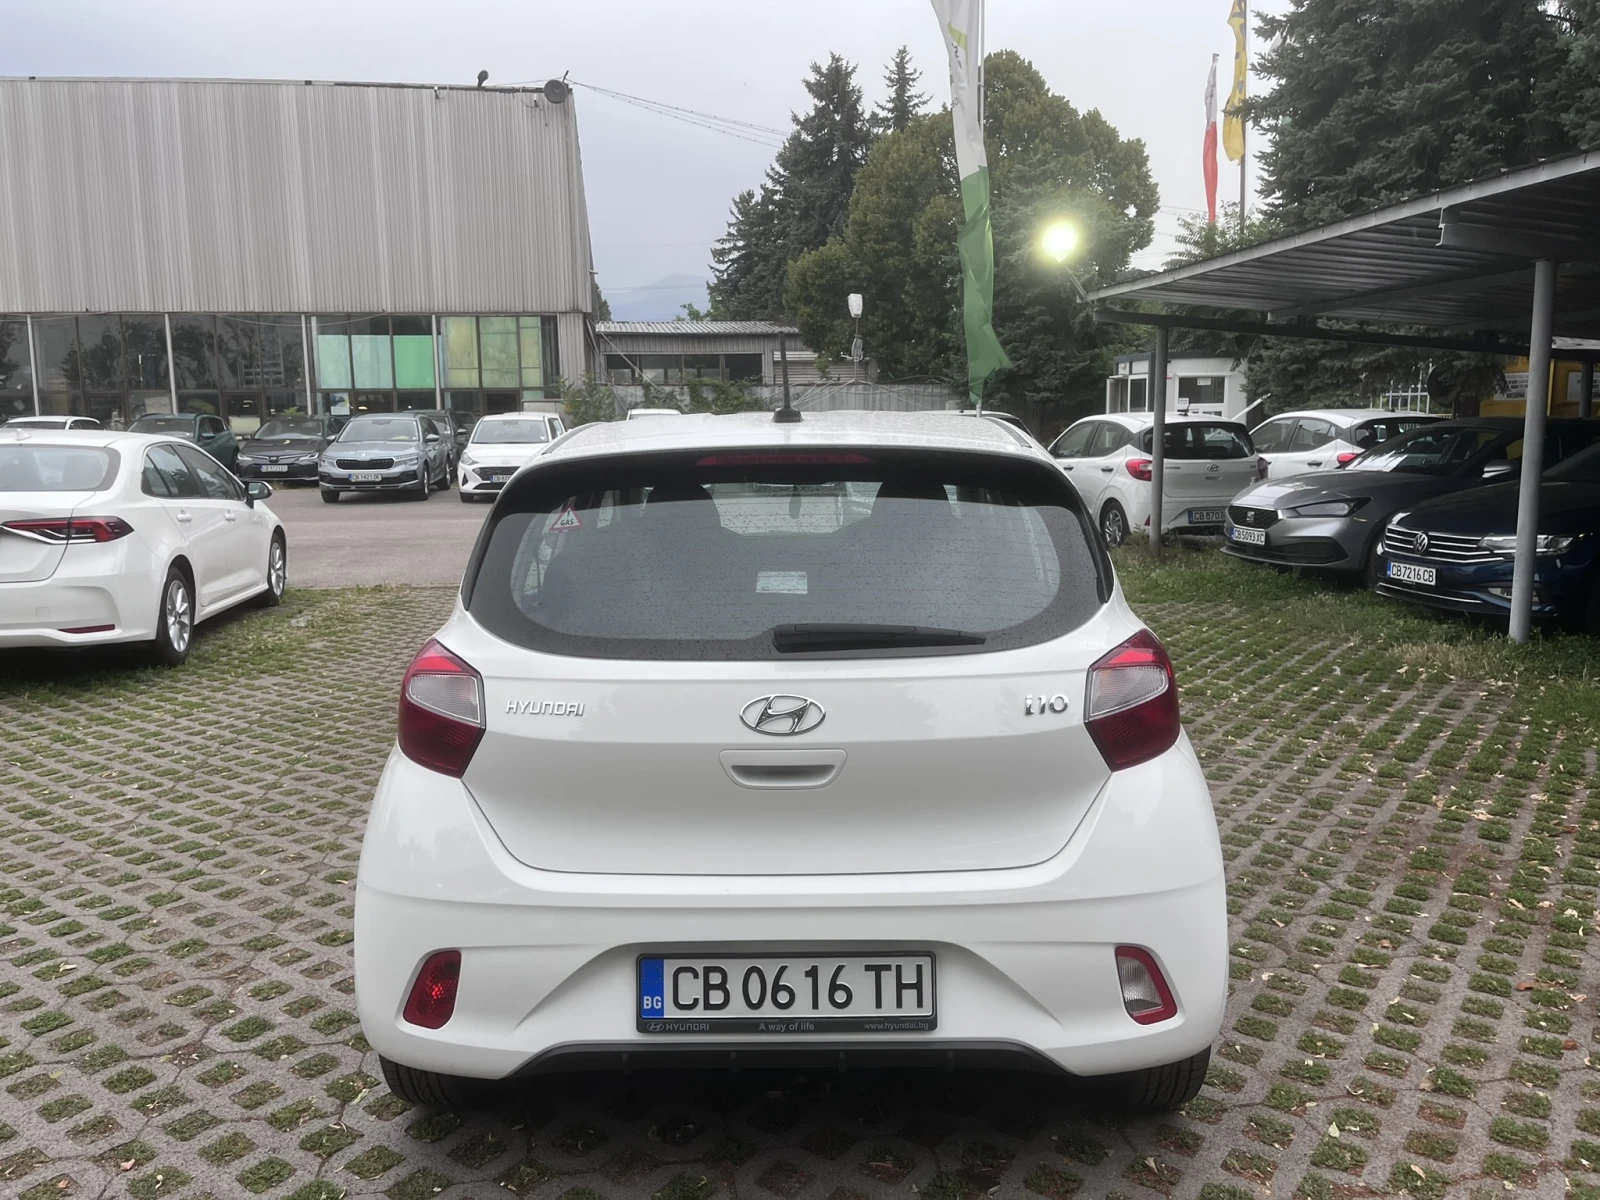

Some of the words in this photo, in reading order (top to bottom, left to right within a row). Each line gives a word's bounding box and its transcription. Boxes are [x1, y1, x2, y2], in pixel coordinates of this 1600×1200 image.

[1194, 512, 1204, 520] CB
[1234, 529, 1242, 539] CB
[1242, 530, 1255, 542] 5093
[1256, 532, 1265, 543] XC
[1392, 564, 1402, 577] CB
[1402, 566, 1422, 580] 7216
[1423, 569, 1434, 582] CB
[506, 700, 585, 717] HYUNDAI
[1024, 693, 1069, 716] i10
[672, 965, 731, 1011] CB
[741, 964, 854, 1010] 0616
[864, 963, 924, 1009] TH
[643, 995, 662, 1009] BG
[666, 1023, 710, 1031] HYUNDAI
[759, 1022, 766, 1031] A
[768, 1023, 787, 1033] way
[789, 1022, 799, 1031] of
[800, 1022, 815, 1031] life
[863, 1021, 929, 1031] www.hyundai.bg
